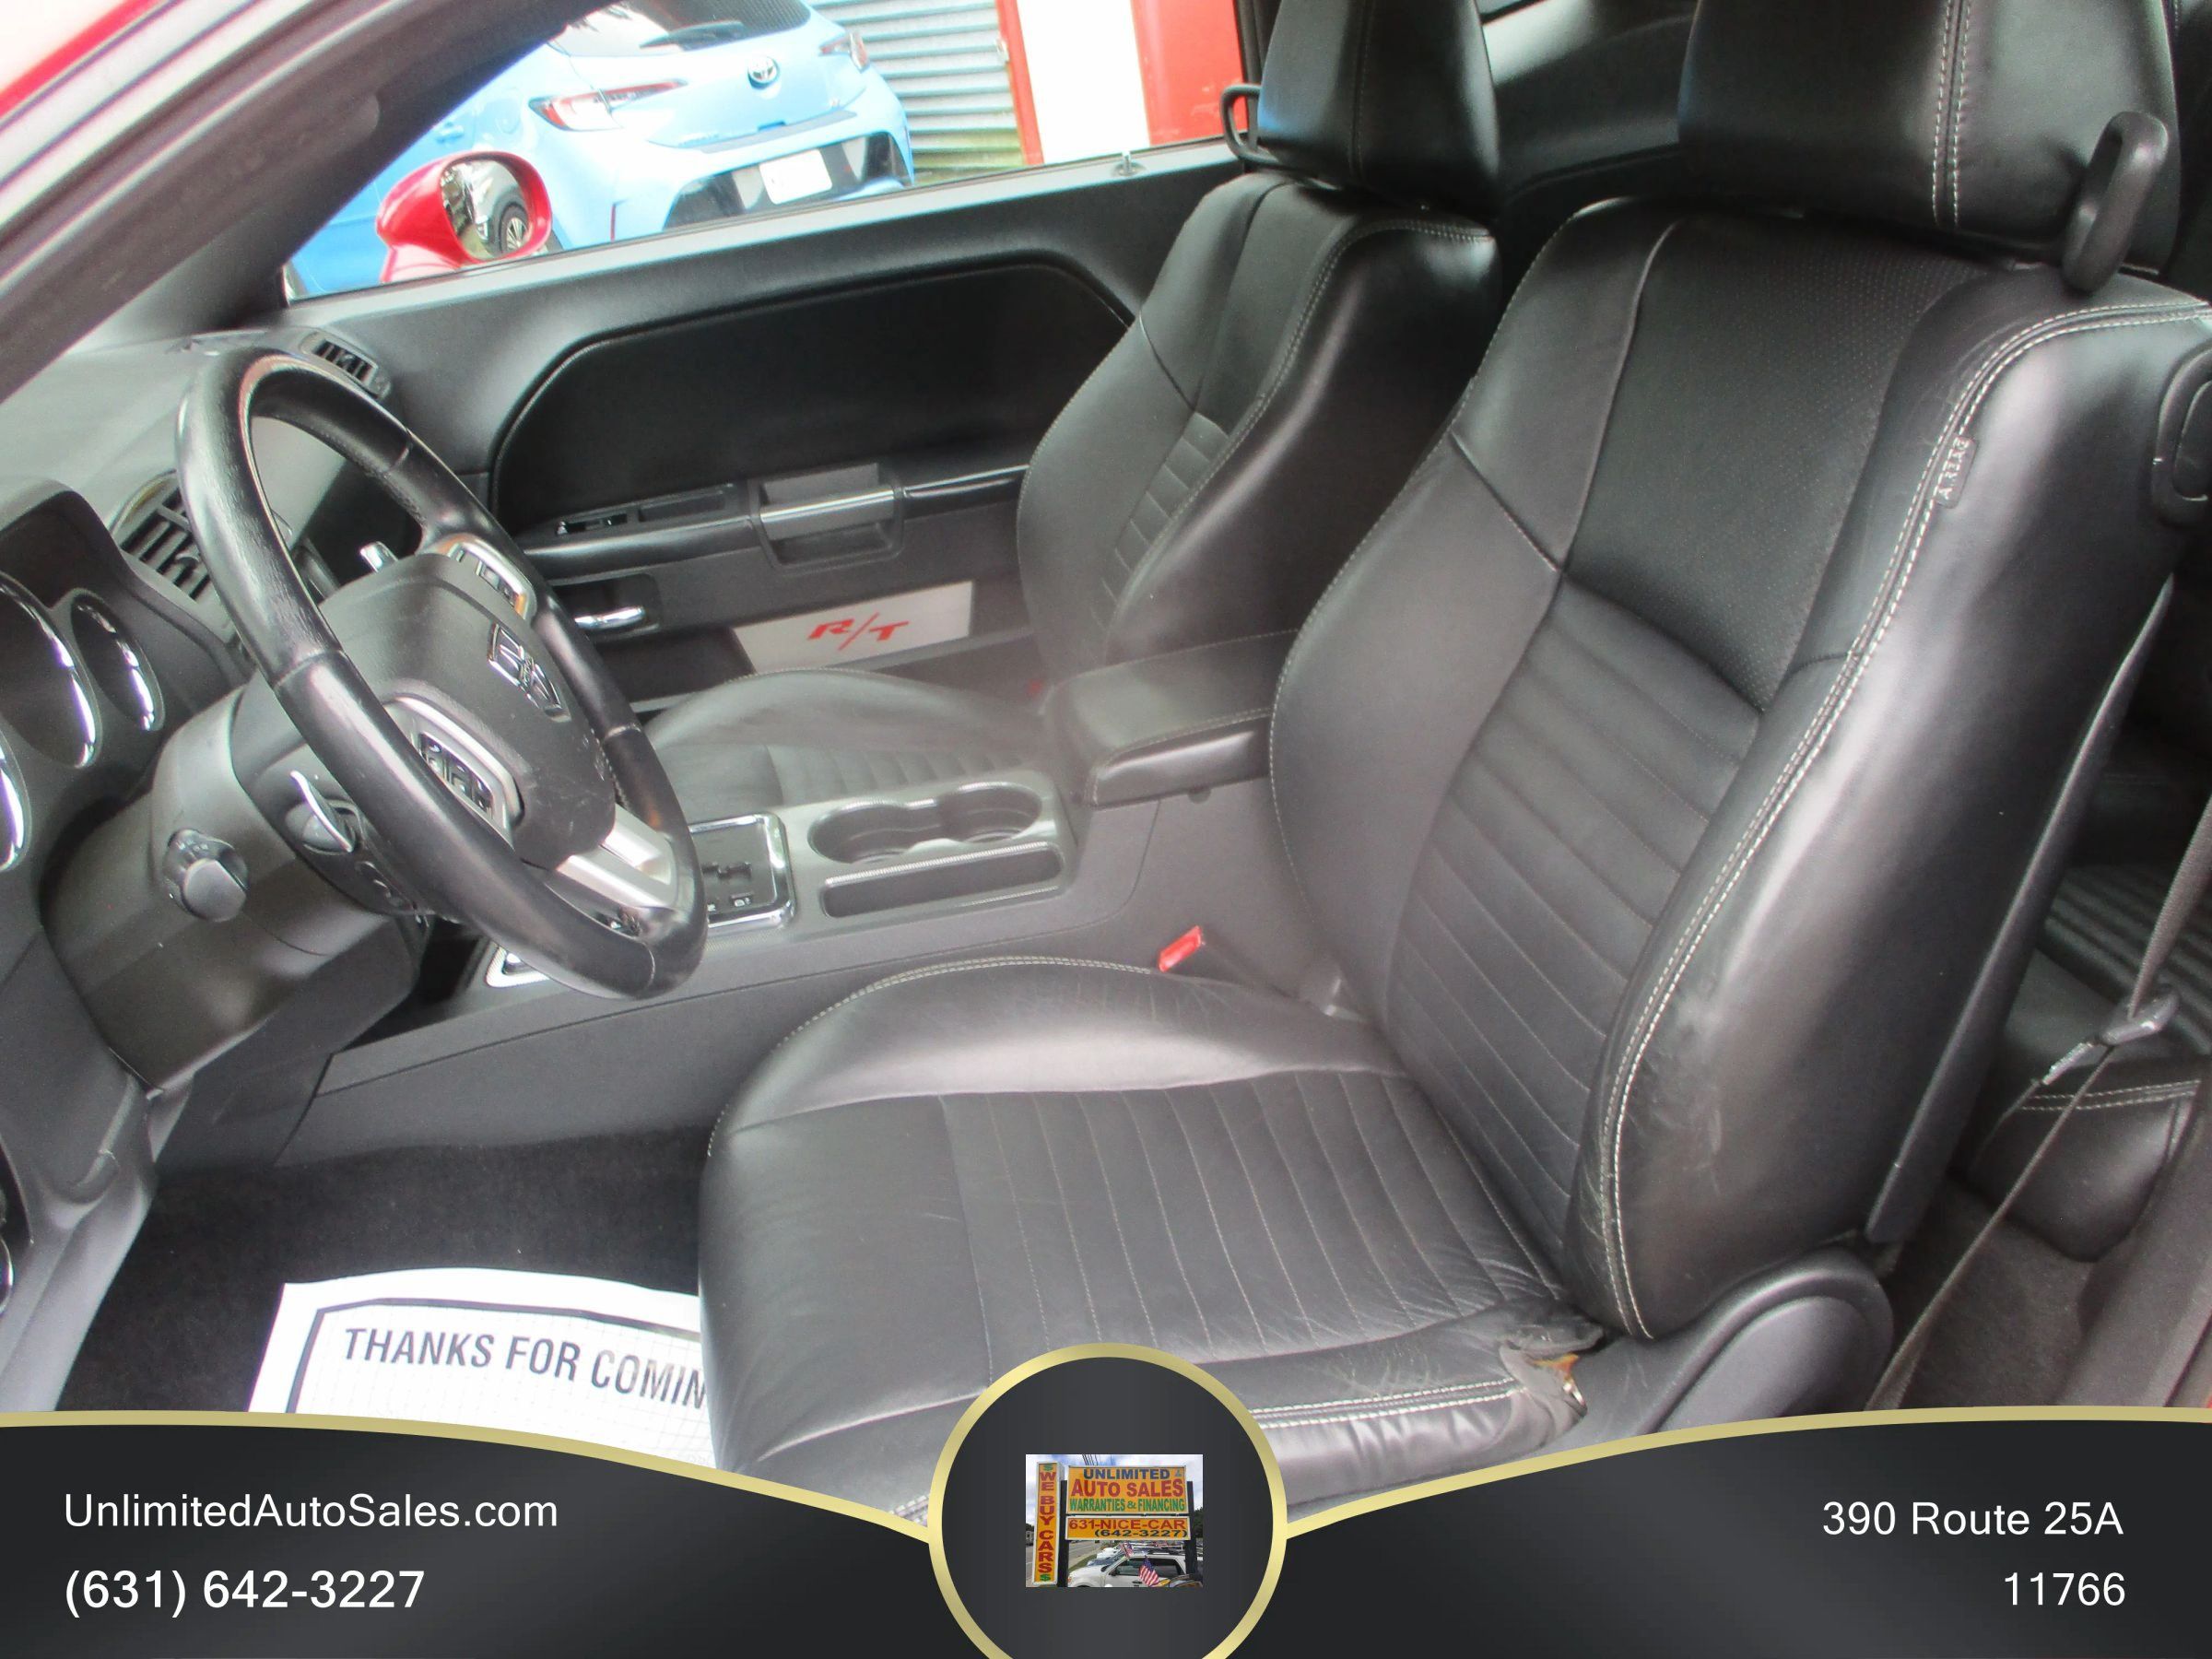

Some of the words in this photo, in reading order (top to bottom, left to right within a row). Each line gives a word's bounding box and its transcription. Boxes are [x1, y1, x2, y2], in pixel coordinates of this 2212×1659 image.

[806, 611, 910, 651] R/T
[345, 1327, 496, 1368] THANKS
[505, 1335, 582, 1382] FOR
